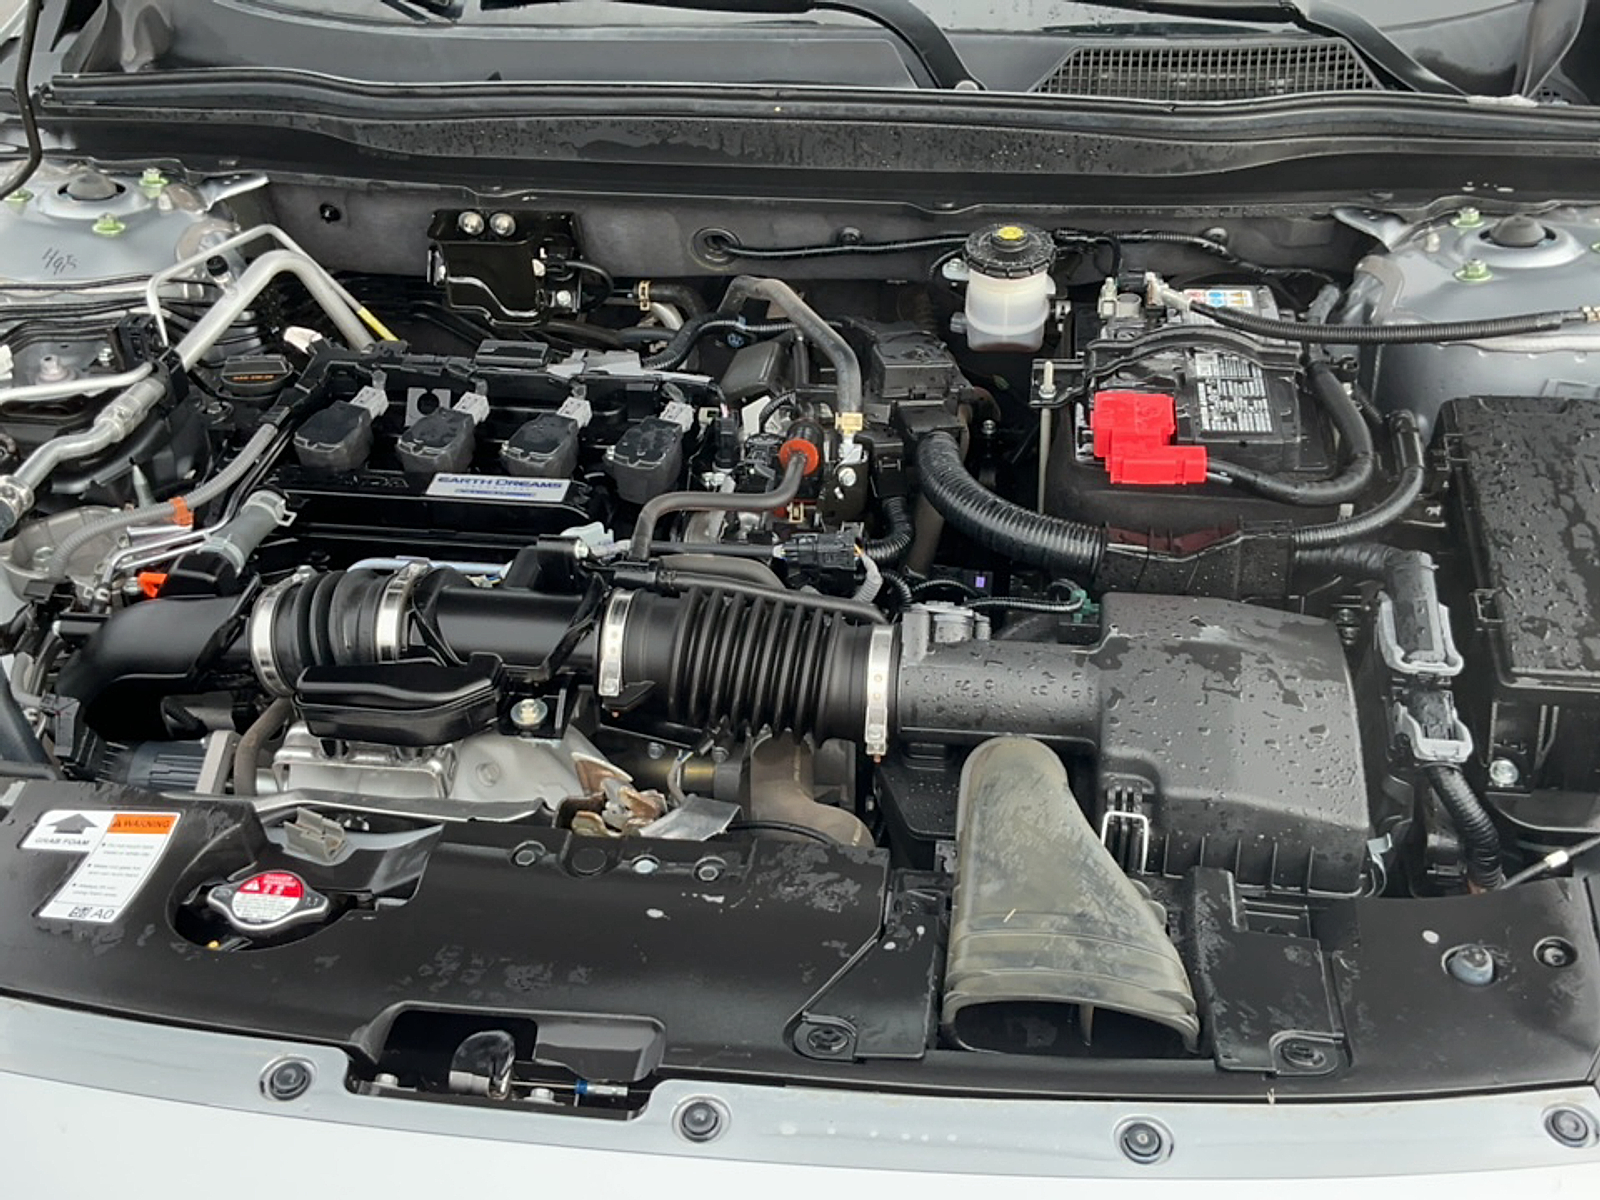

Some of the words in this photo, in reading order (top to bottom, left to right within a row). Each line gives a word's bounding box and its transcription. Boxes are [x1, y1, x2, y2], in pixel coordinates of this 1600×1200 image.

[438, 475, 493, 485] EARTH
[495, 478, 562, 489] DREAMS
[124, 819, 170, 828] WARNING
